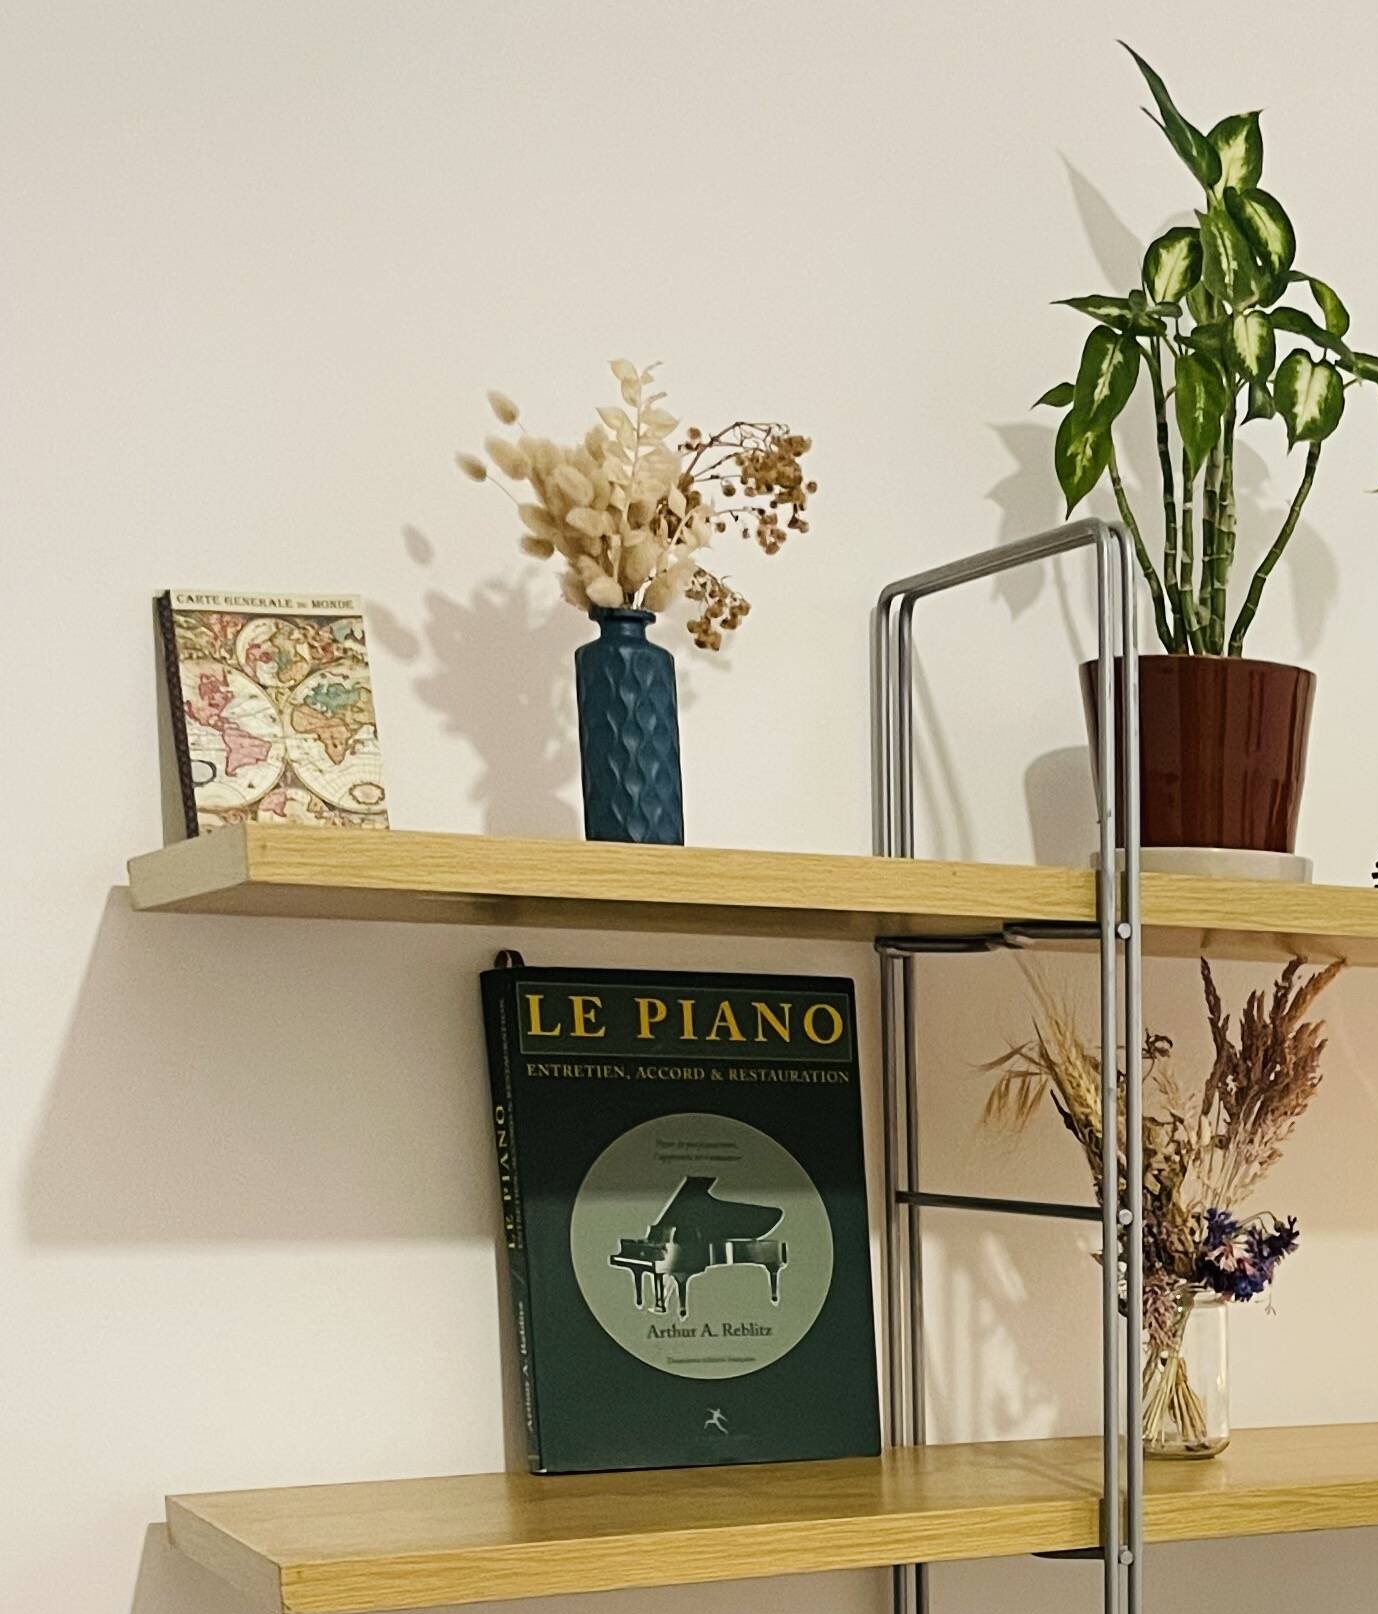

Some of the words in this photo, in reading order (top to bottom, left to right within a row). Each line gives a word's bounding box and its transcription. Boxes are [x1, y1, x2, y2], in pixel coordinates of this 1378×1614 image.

[176, 594, 222, 605] CARTE
[311, 600, 355, 609] MONDE
[525, 994, 606, 1038] LE
[634, 997, 844, 1044] PIANO
[527, 1063, 631, 1080] ENTRETIEN,
[636, 1066, 705, 1081] ACCORD
[710, 1068, 723, 1081] &
[728, 1068, 850, 1083] RESTAURATION
[495, 1105, 512, 1201] PIANO
[647, 1324, 698, 1340] Arthur
[700, 1323, 719, 1338] A.
[722, 1321, 773, 1337] Reblitz
